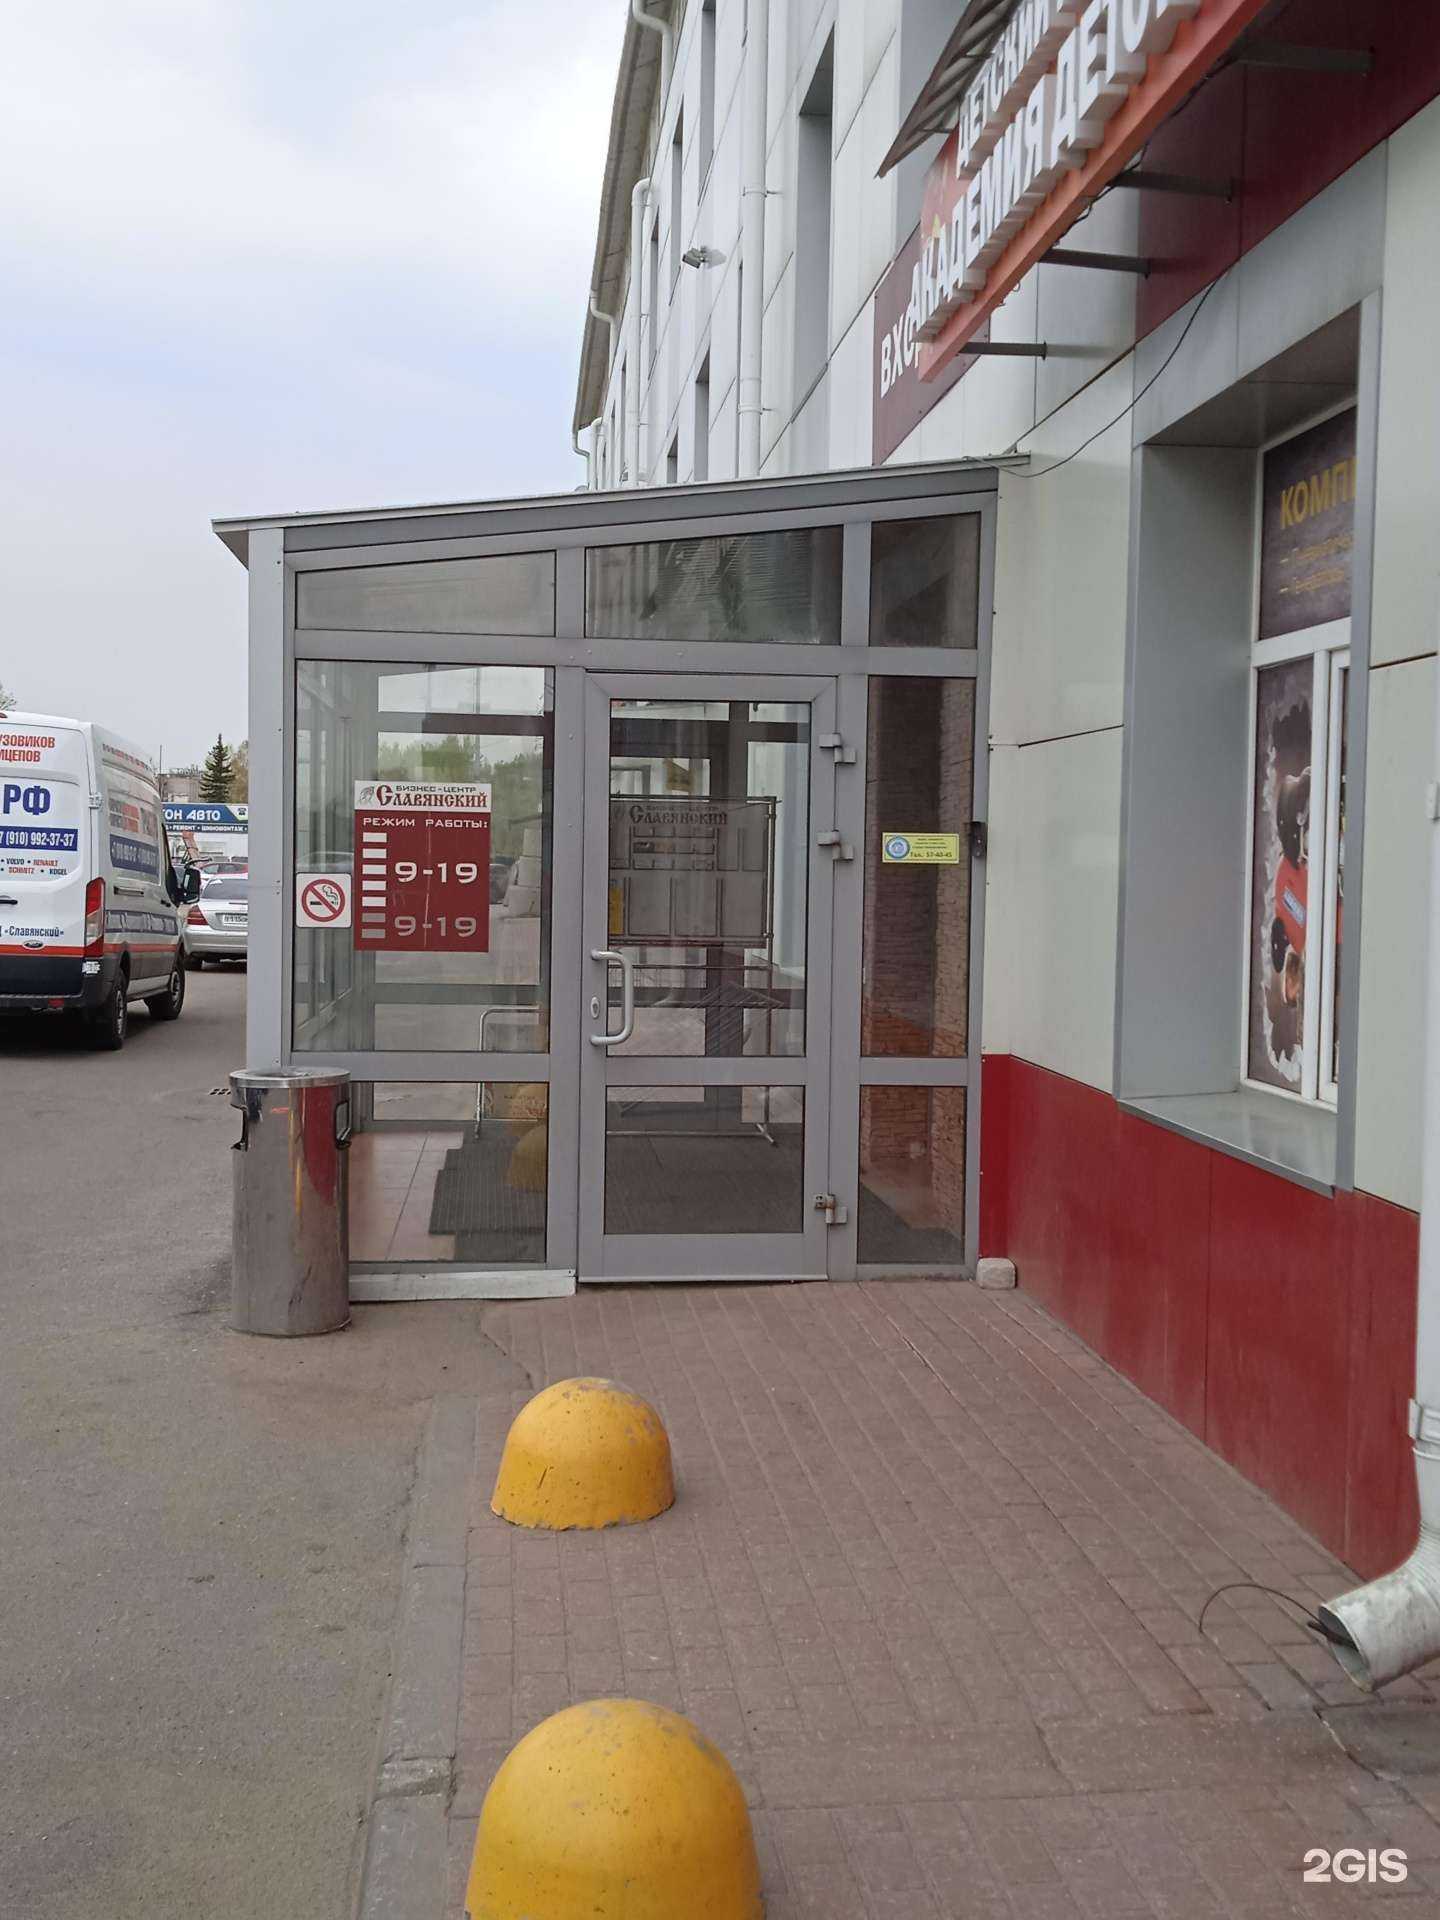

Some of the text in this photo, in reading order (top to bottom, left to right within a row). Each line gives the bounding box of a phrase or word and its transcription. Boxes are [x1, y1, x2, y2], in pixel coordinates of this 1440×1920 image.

[909, 0, 1170, 336] АКАДЕМИЯ ДЕТО
[880, 304, 919, 398] ВХО
[3, 784, 51, 815] РФ
[162, 808, 221, 821] ОН АВТО
[363, 817, 489, 829] РЕЖИМ РАБОТЫ:
[6, 831, 29, 847] (910)
[30, 832, 75, 848] 992-37-37
[394, 861, 479, 885] 9-19
[394, 915, 478, 938] 9-19
